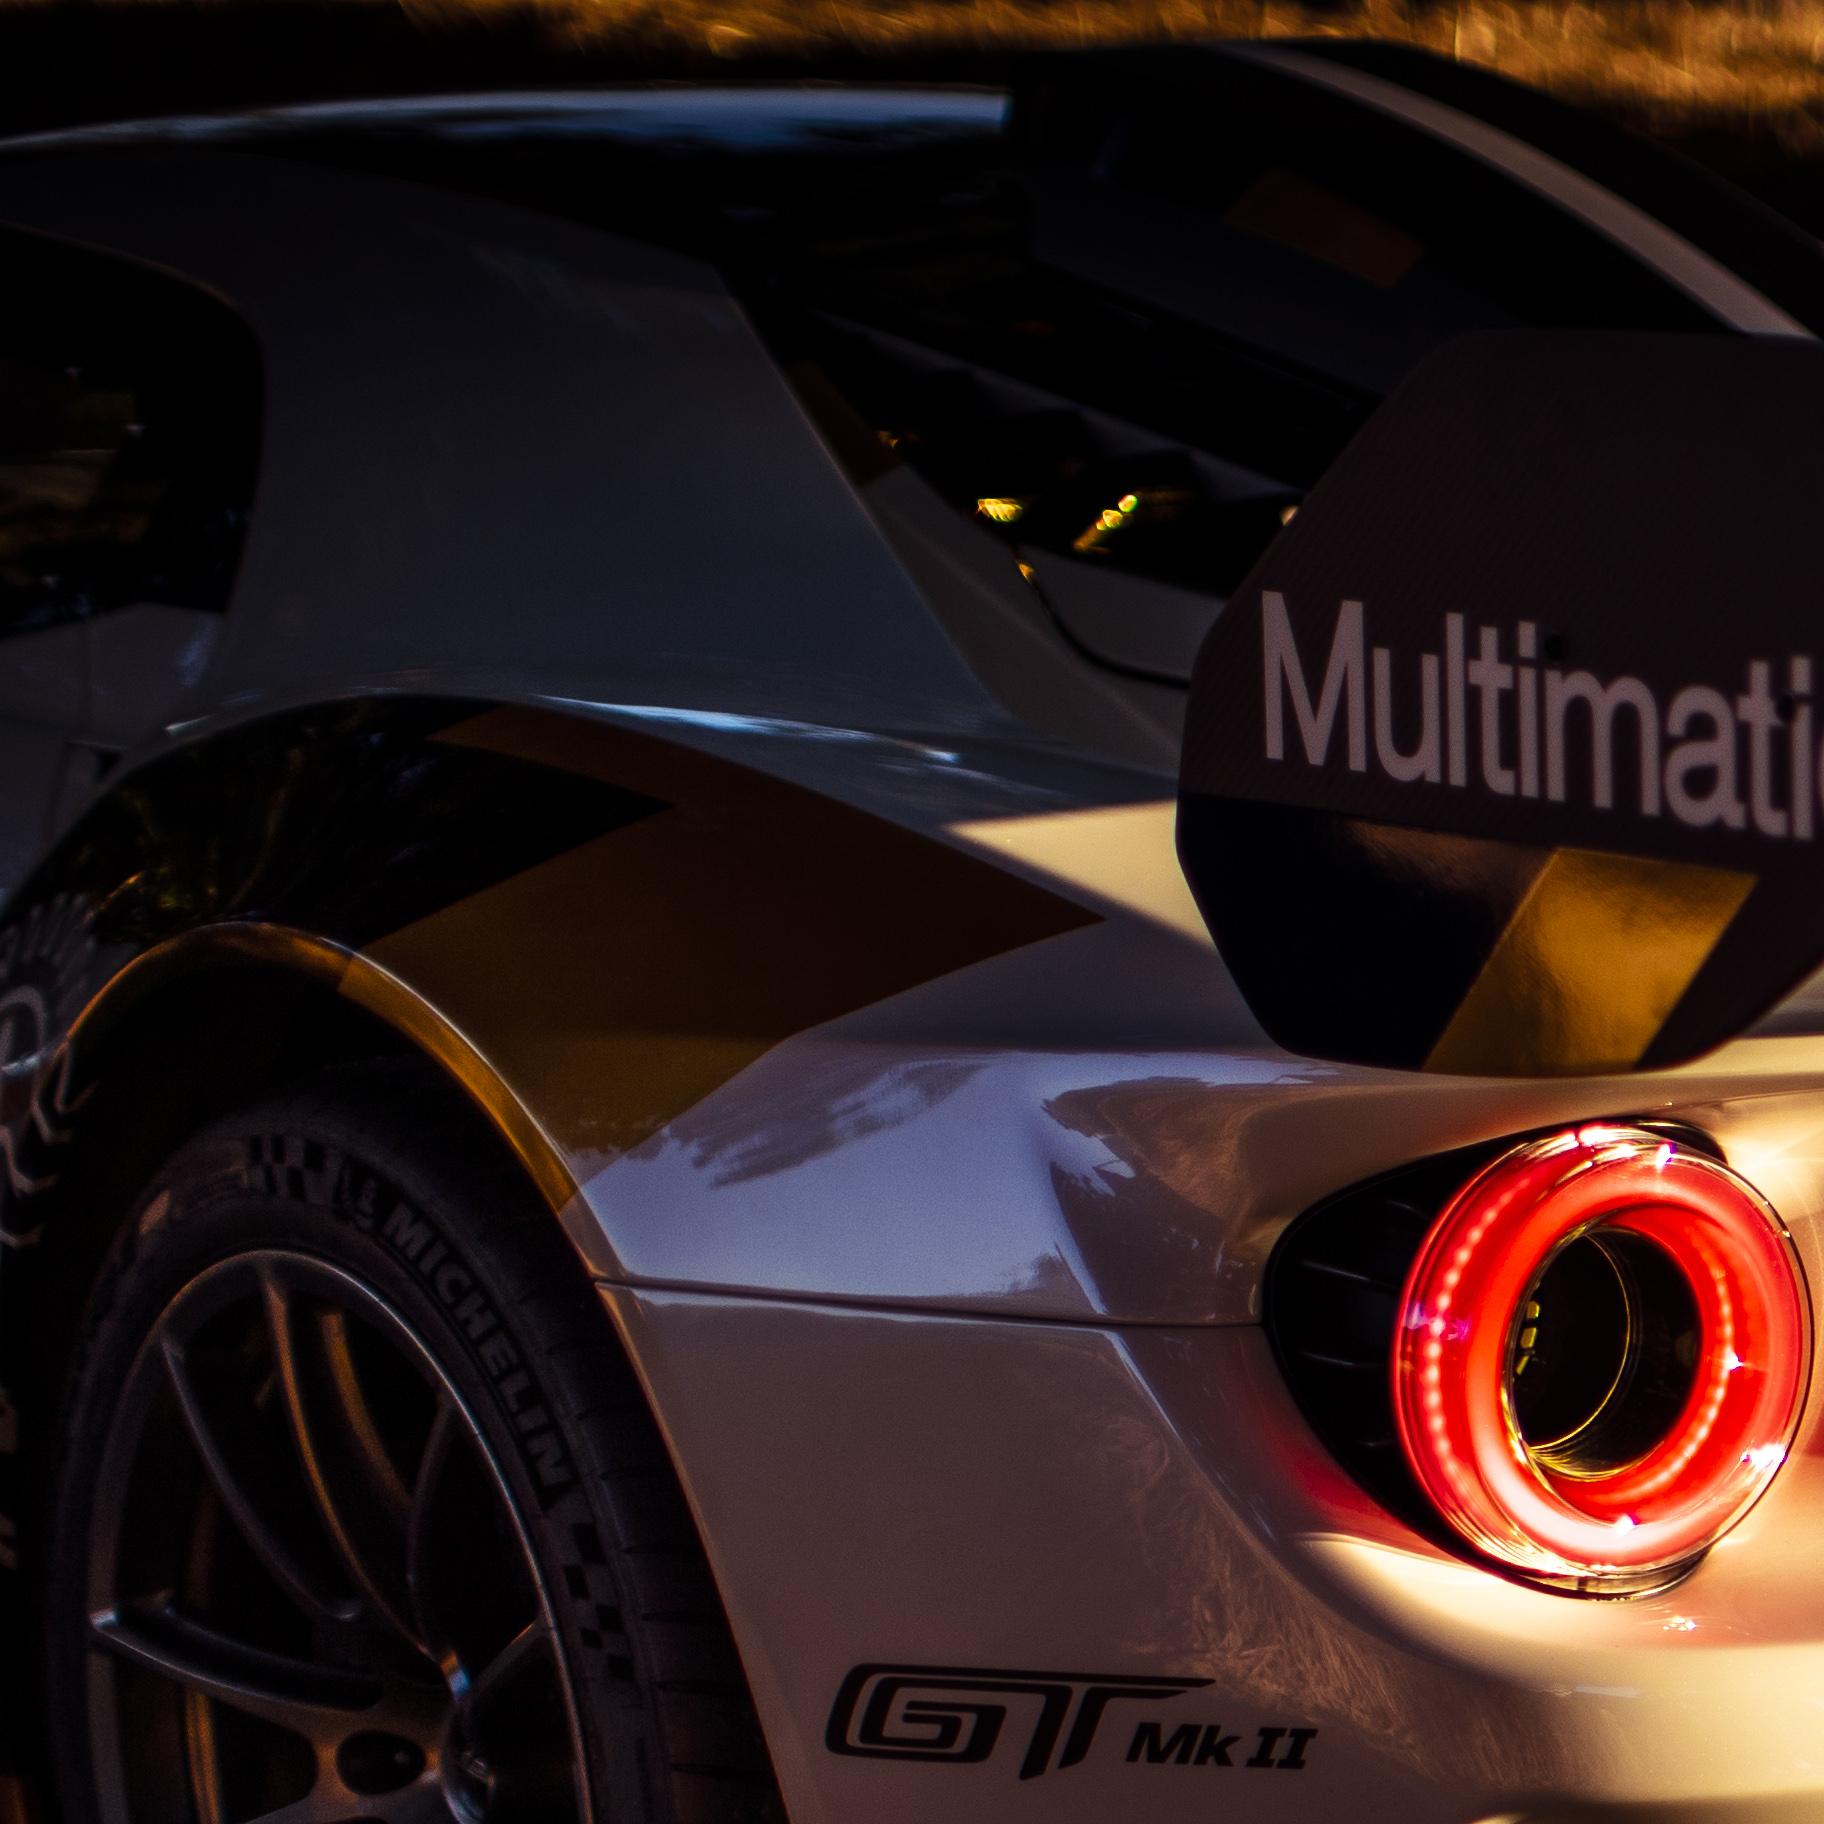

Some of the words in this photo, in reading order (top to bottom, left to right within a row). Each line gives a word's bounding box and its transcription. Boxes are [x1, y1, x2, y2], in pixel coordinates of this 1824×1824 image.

[382, 1201, 579, 1493] MICHELIN
[826, 1663, 1216, 1780] GT
[1127, 1723, 1241, 1767] Mk
